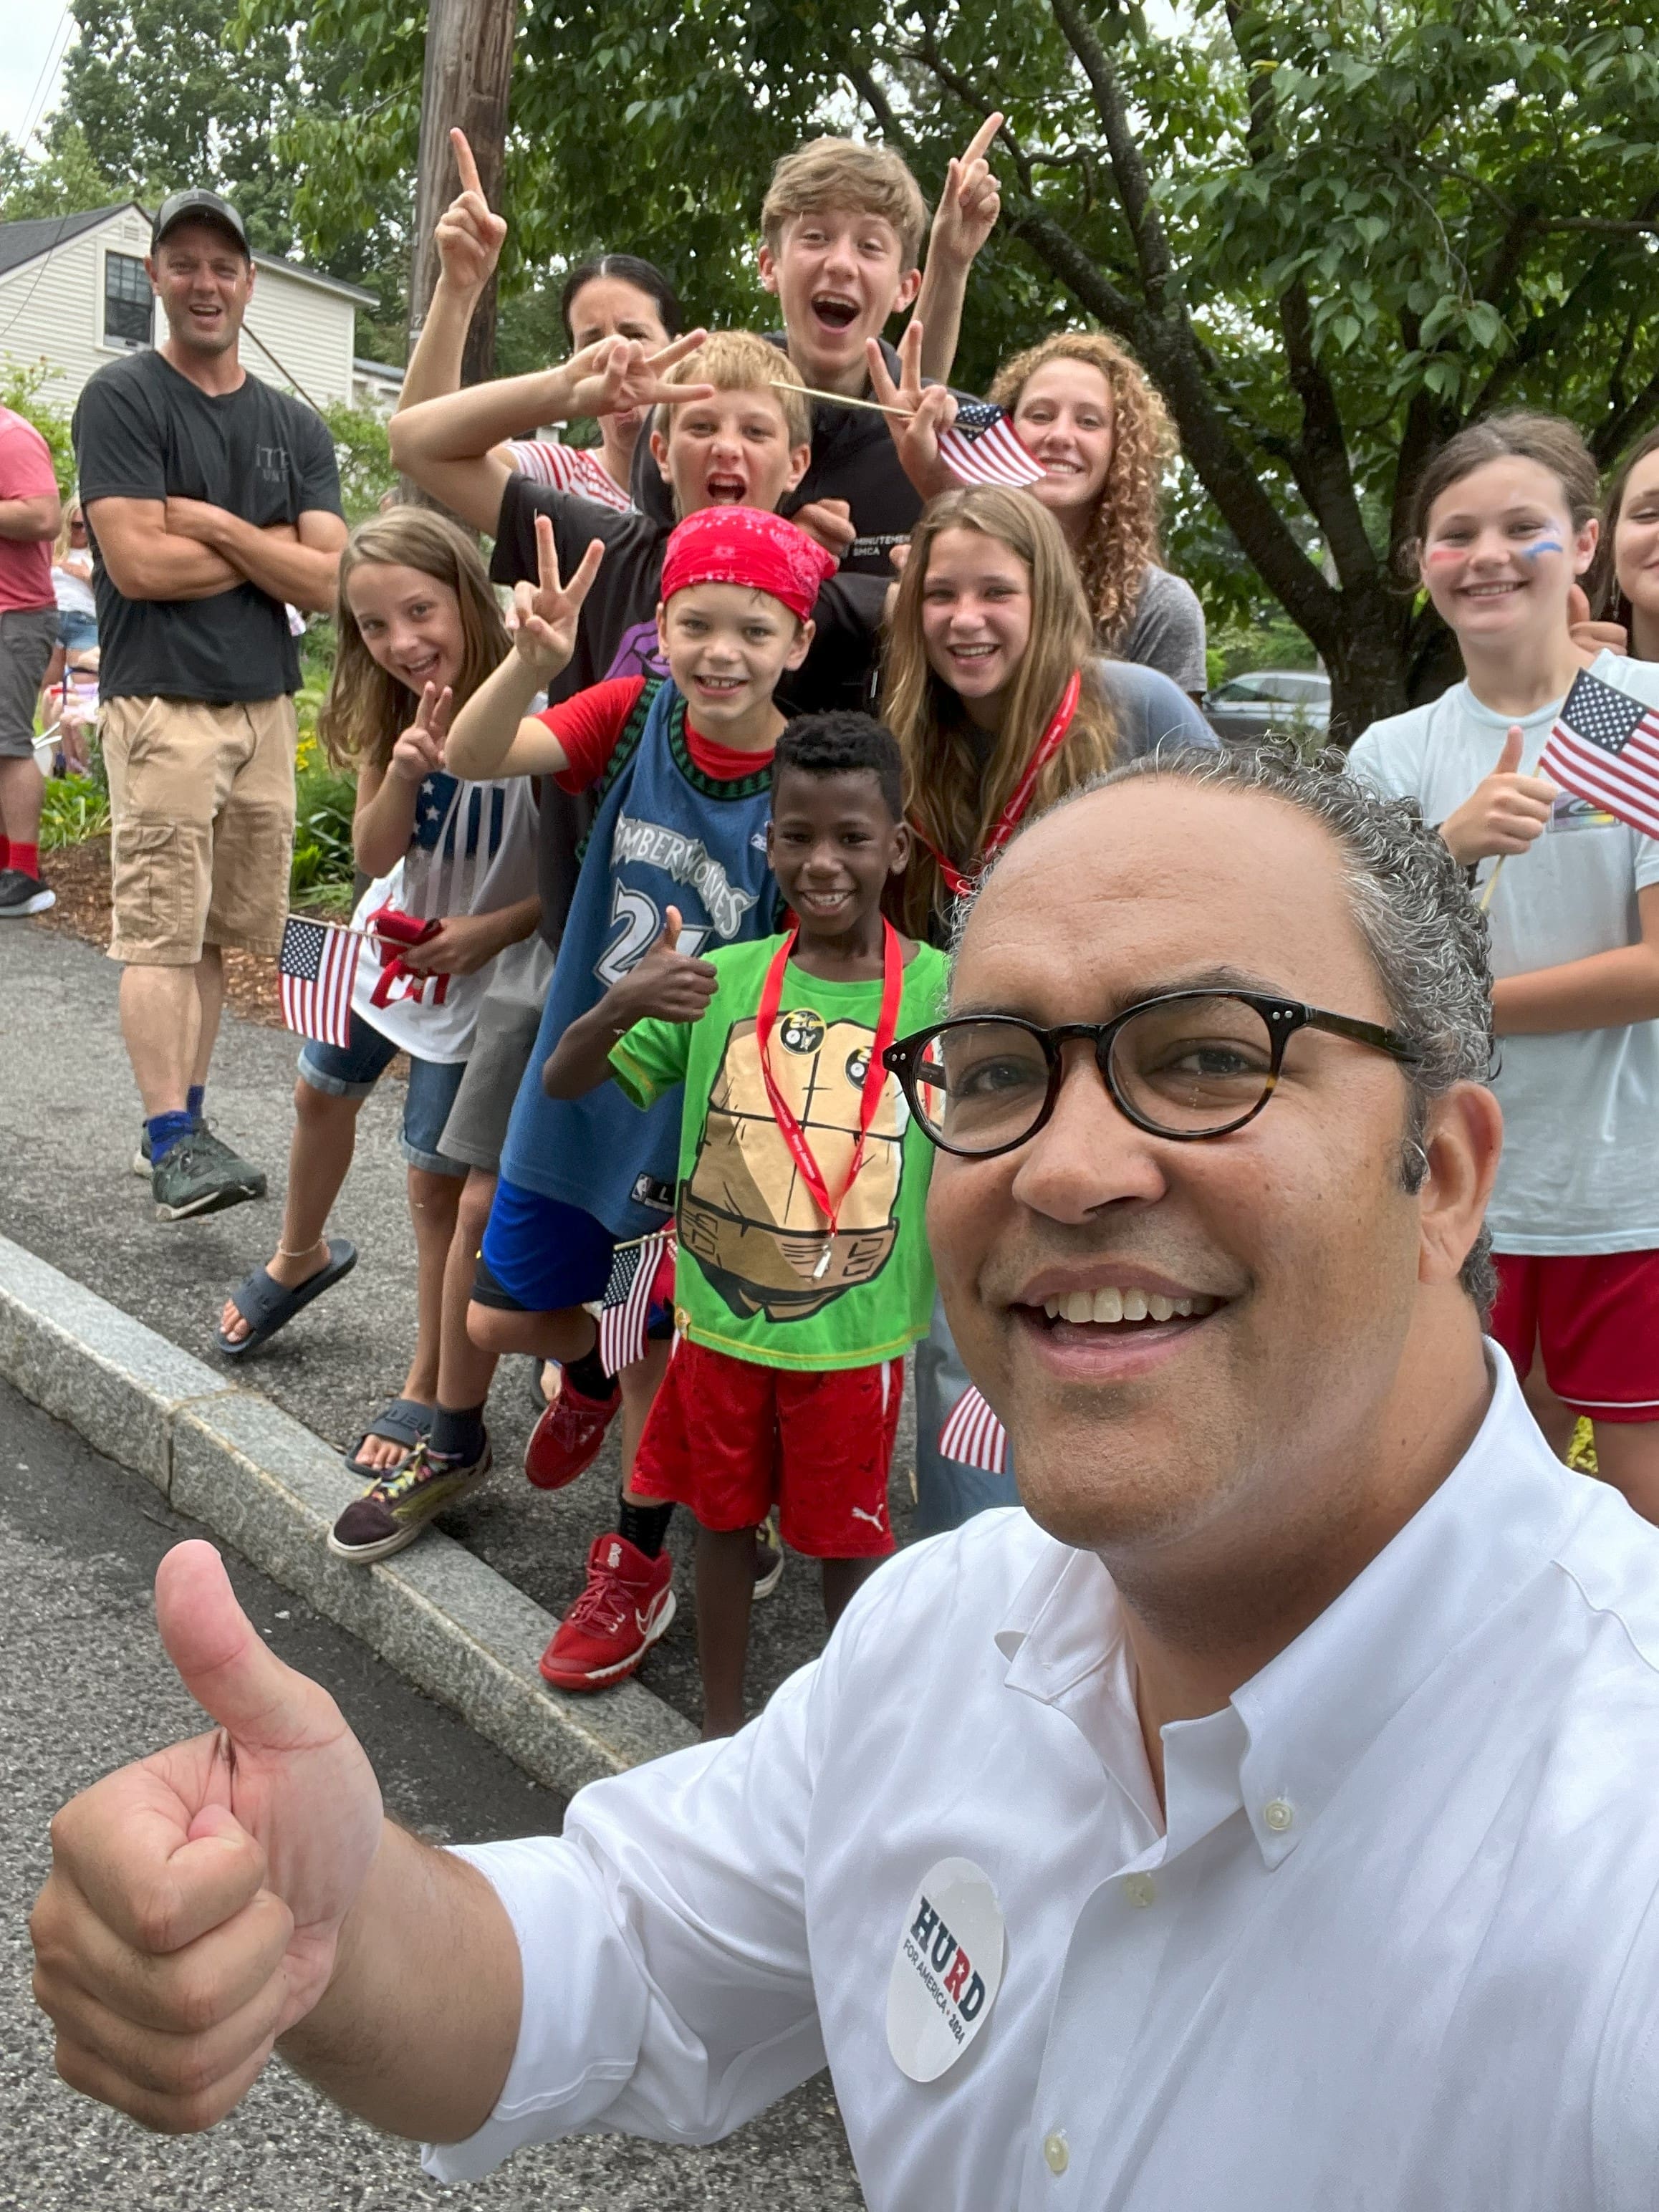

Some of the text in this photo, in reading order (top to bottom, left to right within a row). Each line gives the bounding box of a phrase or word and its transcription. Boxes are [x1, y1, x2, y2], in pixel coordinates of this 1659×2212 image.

[658, 1186, 668, 1201] L
[903, 1938, 966, 2045] FOR AMERICA 2024
[910, 1895, 986, 2022] HURD
